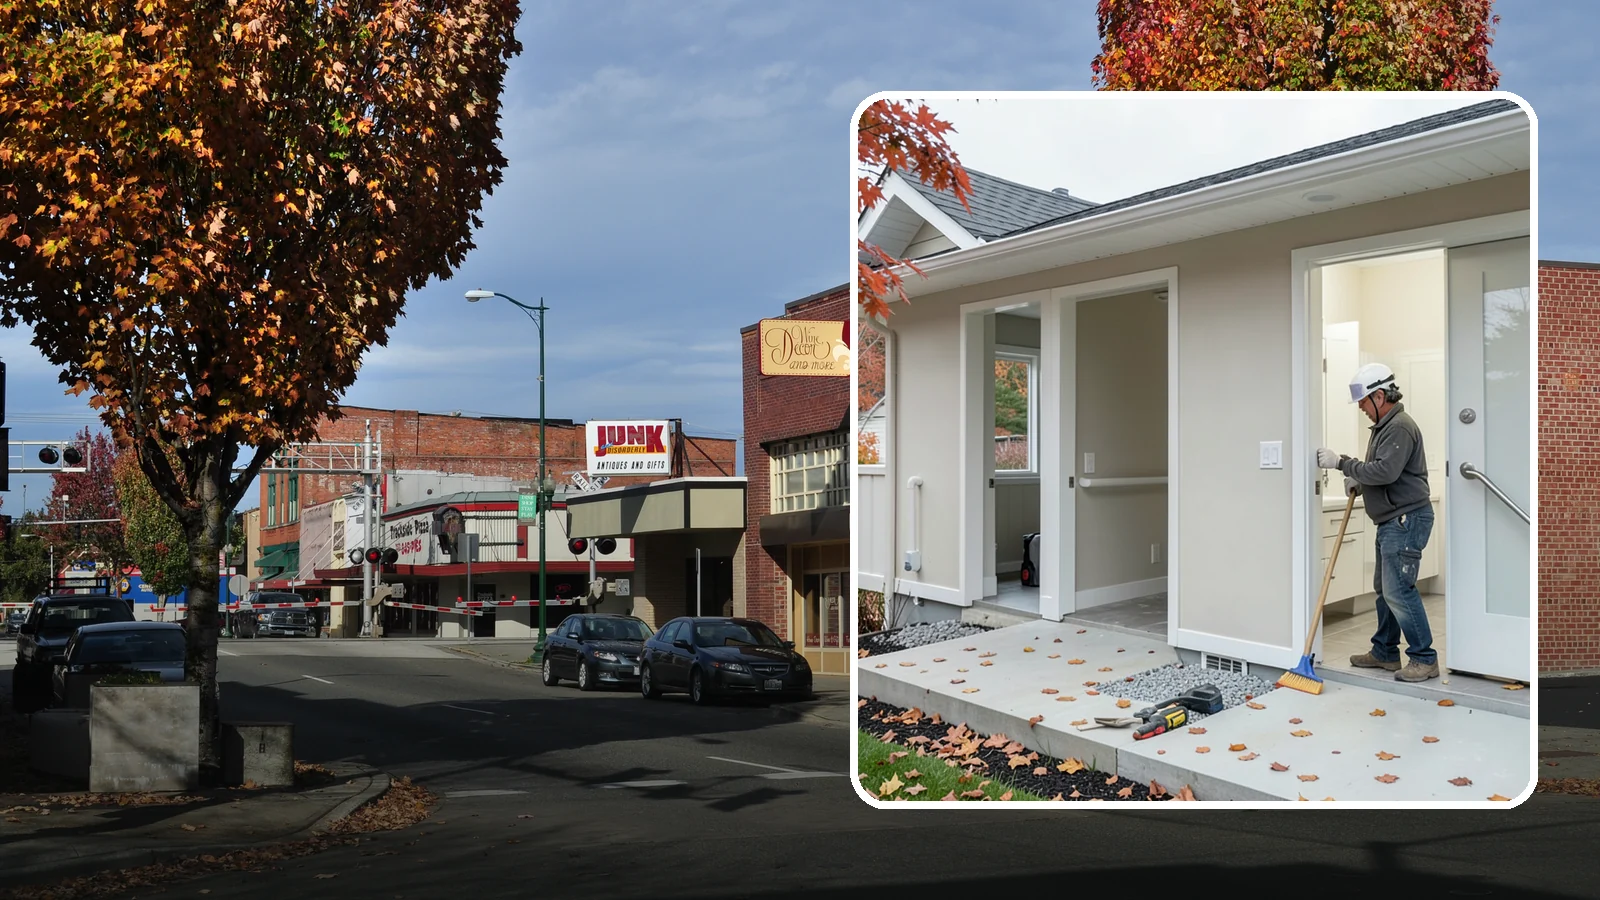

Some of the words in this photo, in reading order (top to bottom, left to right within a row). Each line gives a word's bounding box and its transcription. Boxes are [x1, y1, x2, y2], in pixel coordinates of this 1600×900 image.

[595, 425, 665, 457] JUNK
[608, 446, 645, 454] DISORDERLY
[597, 461, 628, 470] ANTIQUES
[631, 461, 644, 470] AND
[647, 460, 665, 469] GIFTS
[390, 521, 413, 540] Trackside
[414, 519, 429, 535] Pizza
